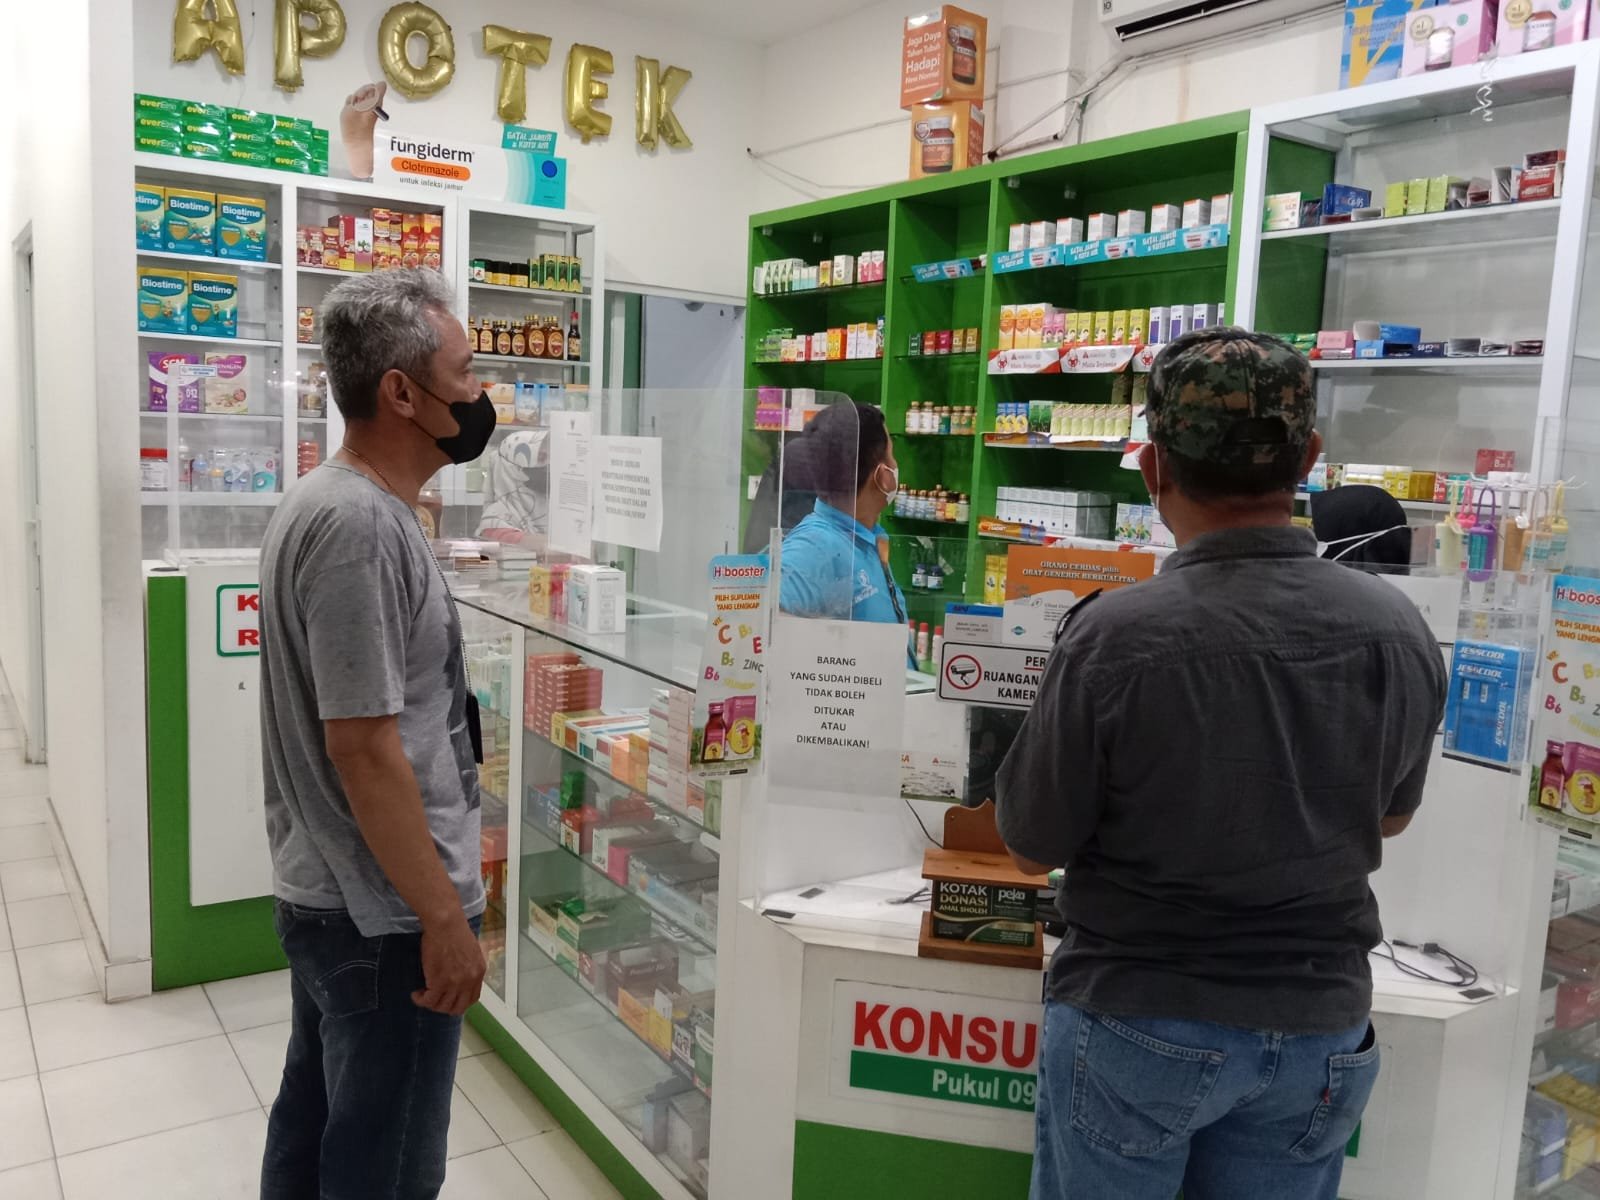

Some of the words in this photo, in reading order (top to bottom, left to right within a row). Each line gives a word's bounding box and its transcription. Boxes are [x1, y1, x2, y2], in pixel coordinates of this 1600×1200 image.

[924, 31, 942, 42] Daya
[906, 54, 941, 74] Hadapi
[172, 0, 693, 153] APOTEK
[391, 136, 473, 163] Fungiderm
[401, 160, 460, 178] Clotrimazole
[399, 176, 419, 185] untuk
[421, 179, 443, 188] infeksi
[444, 182, 463, 191] jamur
[170, 199, 210, 213] Biostime
[222, 205, 261, 218] Biostime
[151, 219, 160, 231] 3
[202, 225, 211, 237] 3
[142, 278, 182, 290] Biostime
[193, 283, 232, 295] Biostime
[1040, 561, 1068, 570] ORANG
[1069, 563, 1101, 572] CERDAS
[1022, 568, 1043, 577] OBAT
[1044, 570, 1080, 580] GENERIK
[1081, 573, 1137, 584] BERKUALITAS
[730, 593, 760, 602] SUPLEMEN
[733, 602, 760, 610] LENGKAP
[718, 624, 732, 645] C
[1556, 630, 1576, 639] YANG
[752, 636, 763, 654] E
[721, 651, 735, 666] B5
[1459, 646, 1504, 660] JESSCOOL
[743, 659, 764, 673] ZINC
[817, 656, 856, 667] BARANG
[704, 666, 720, 681] B6
[790, 672, 816, 681] YANG
[818, 674, 851, 684] SUDAH
[853, 676, 882, 686] DIBELI
[984, 671, 1039, 686] RUANGAN
[1552, 662, 1568, 683] C
[805, 687, 833, 698] TIDAK
[835, 690, 865, 700] BOLEH
[1570, 685, 1586, 704] B5
[1545, 694, 1562, 714] B6
[814, 706, 855, 717] DITUKAR
[820, 721, 847, 731] ATAU
[796, 735, 870, 748] DIKEMBALIKAN!
[940, 882, 988, 896] KOTAK
[940, 894, 988, 906] DONASI
[939, 904, 959, 913] AMAL
[960, 906, 988, 915] SHOLEH
[854, 1001, 1037, 1068] KONSU
[932, 1069, 1000, 1101] Pukul
[1008, 1079, 1036, 1105] 09
